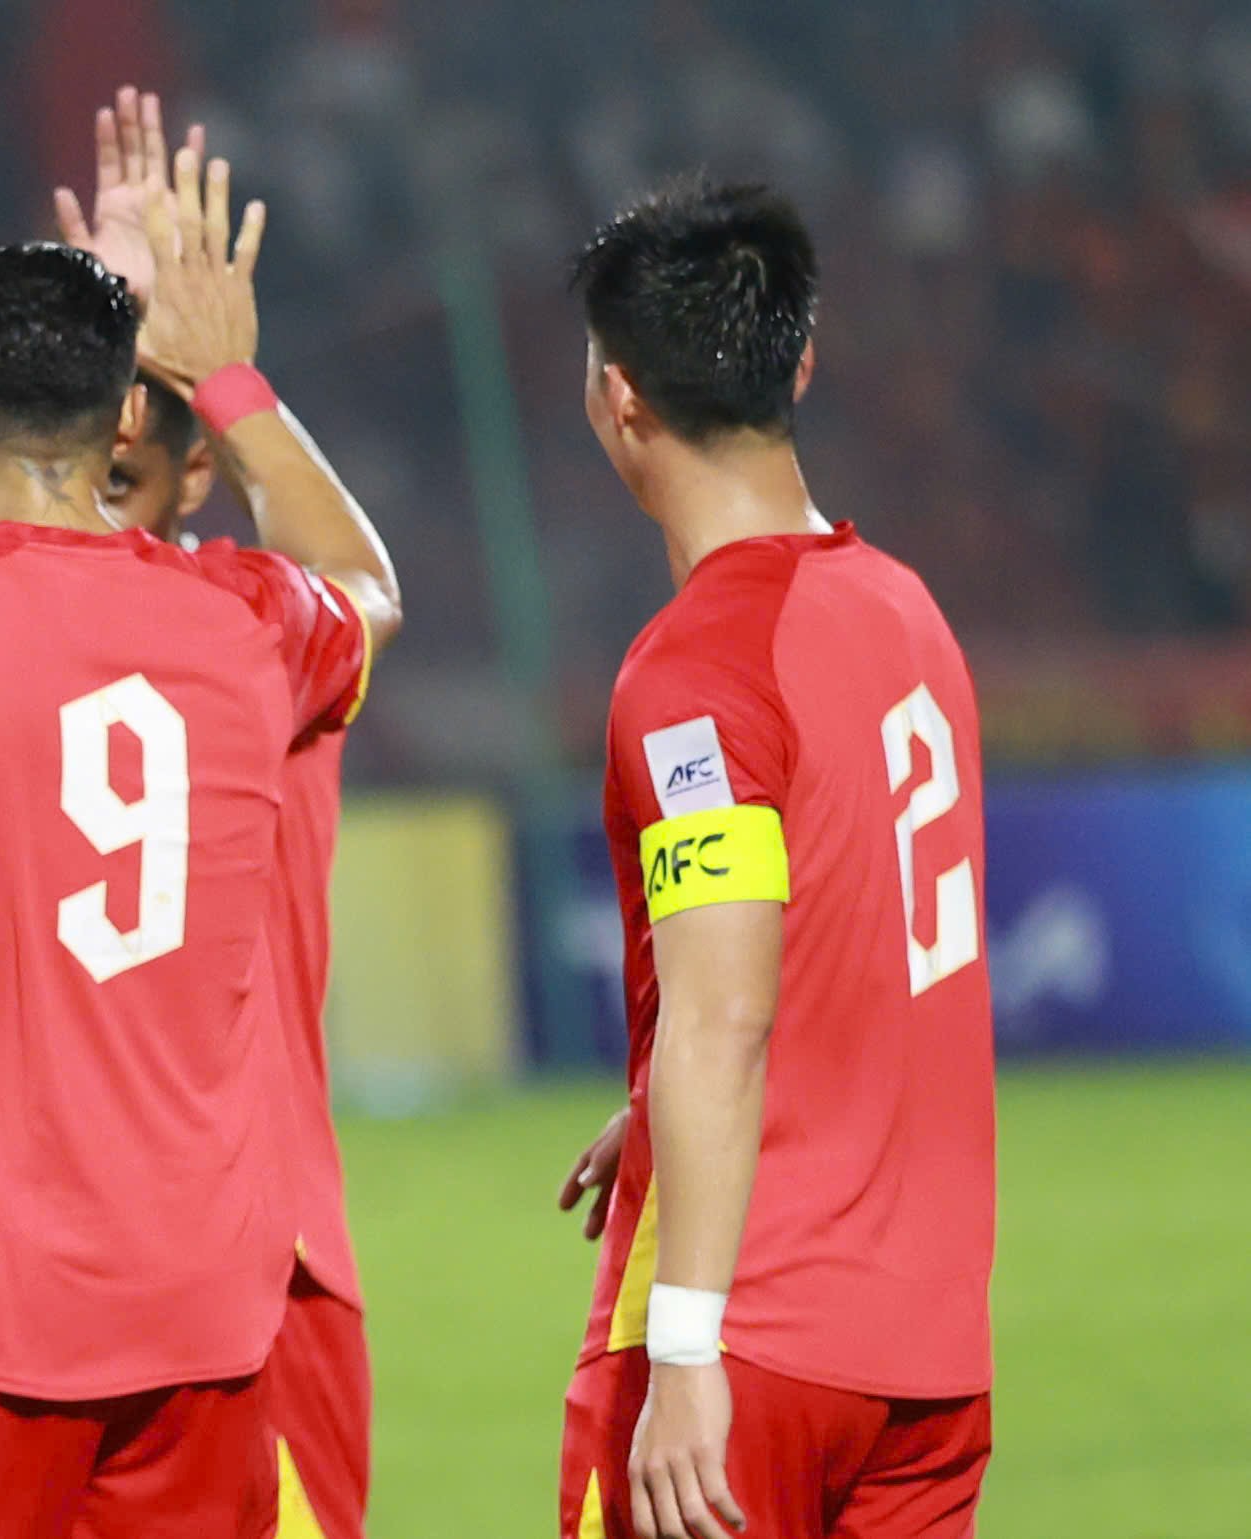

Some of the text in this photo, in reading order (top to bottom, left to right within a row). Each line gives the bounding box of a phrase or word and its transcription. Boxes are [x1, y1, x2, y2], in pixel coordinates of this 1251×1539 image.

[57, 672, 190, 984] 9
[648, 833, 730, 899] AFC
[666, 754, 716, 789] AFC
[880, 681, 979, 998] 2
